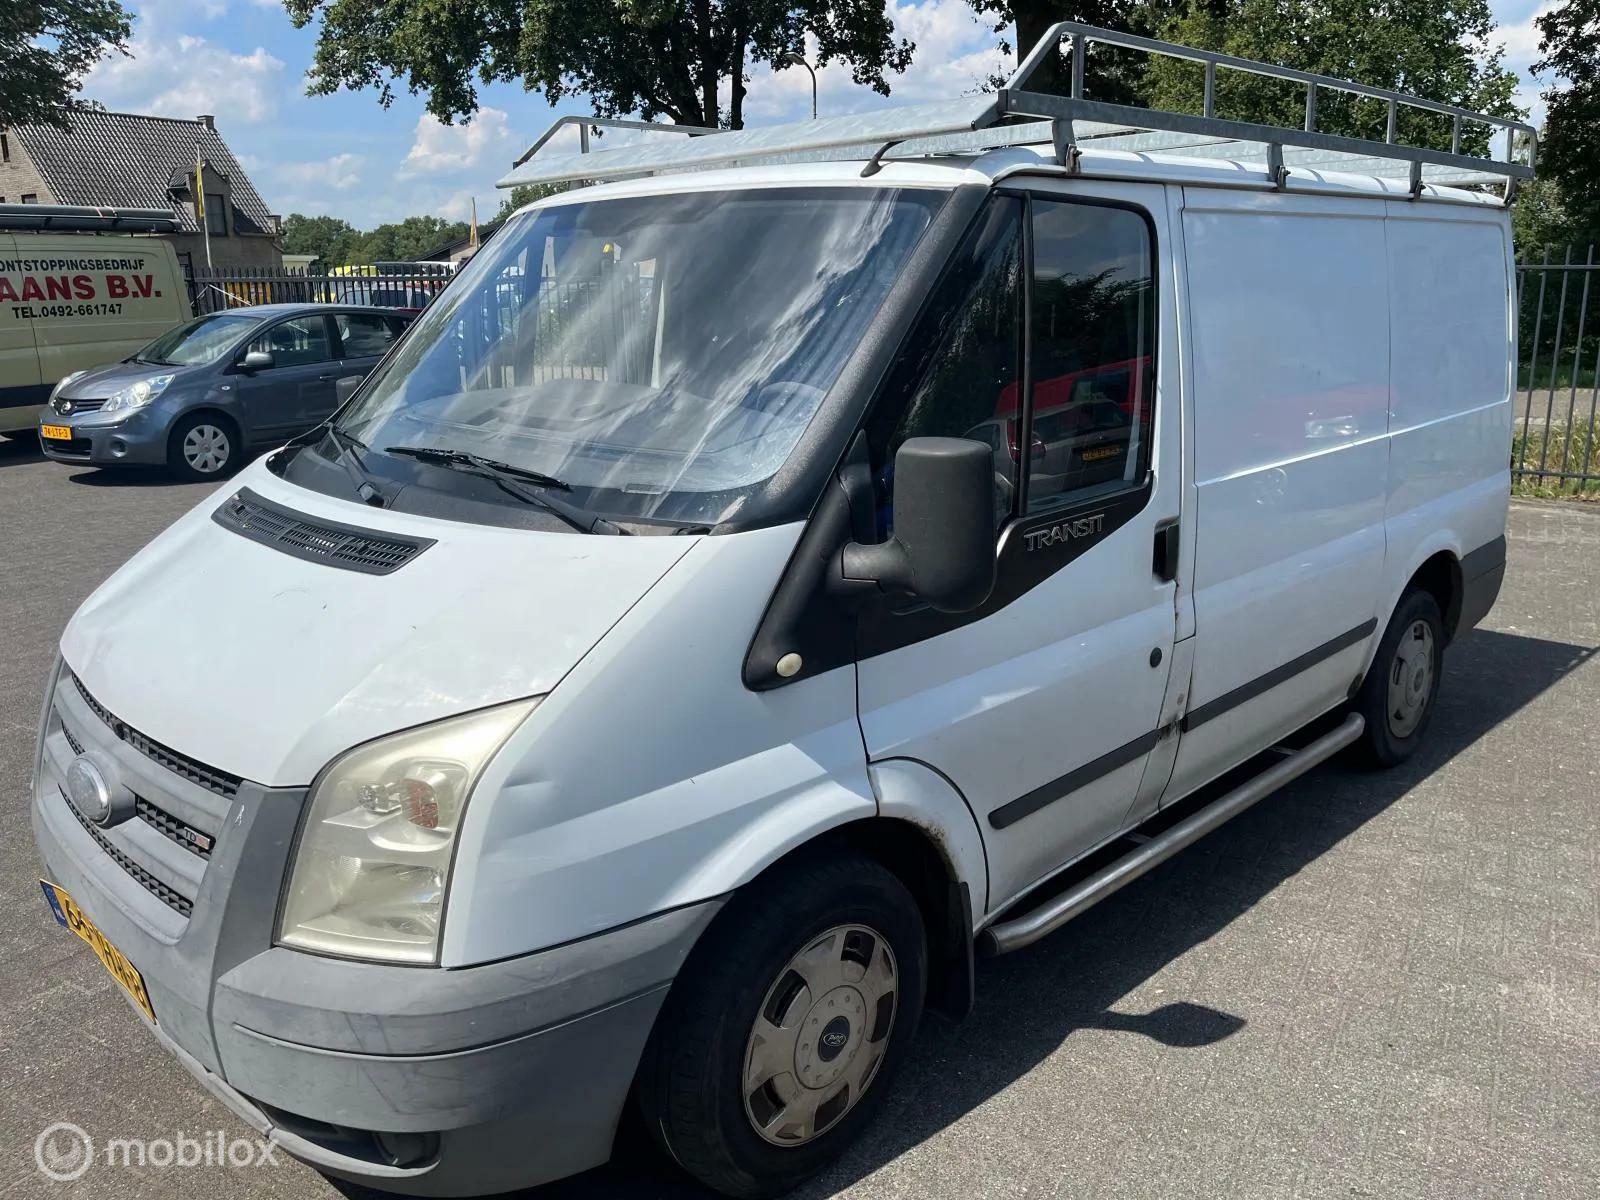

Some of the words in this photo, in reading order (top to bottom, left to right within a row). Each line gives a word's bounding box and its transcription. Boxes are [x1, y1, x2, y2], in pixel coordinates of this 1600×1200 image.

[0, 275, 96, 302] AANS
[106, 275, 162, 299] B.V.
[1023, 513, 1105, 552] TRANSIT
